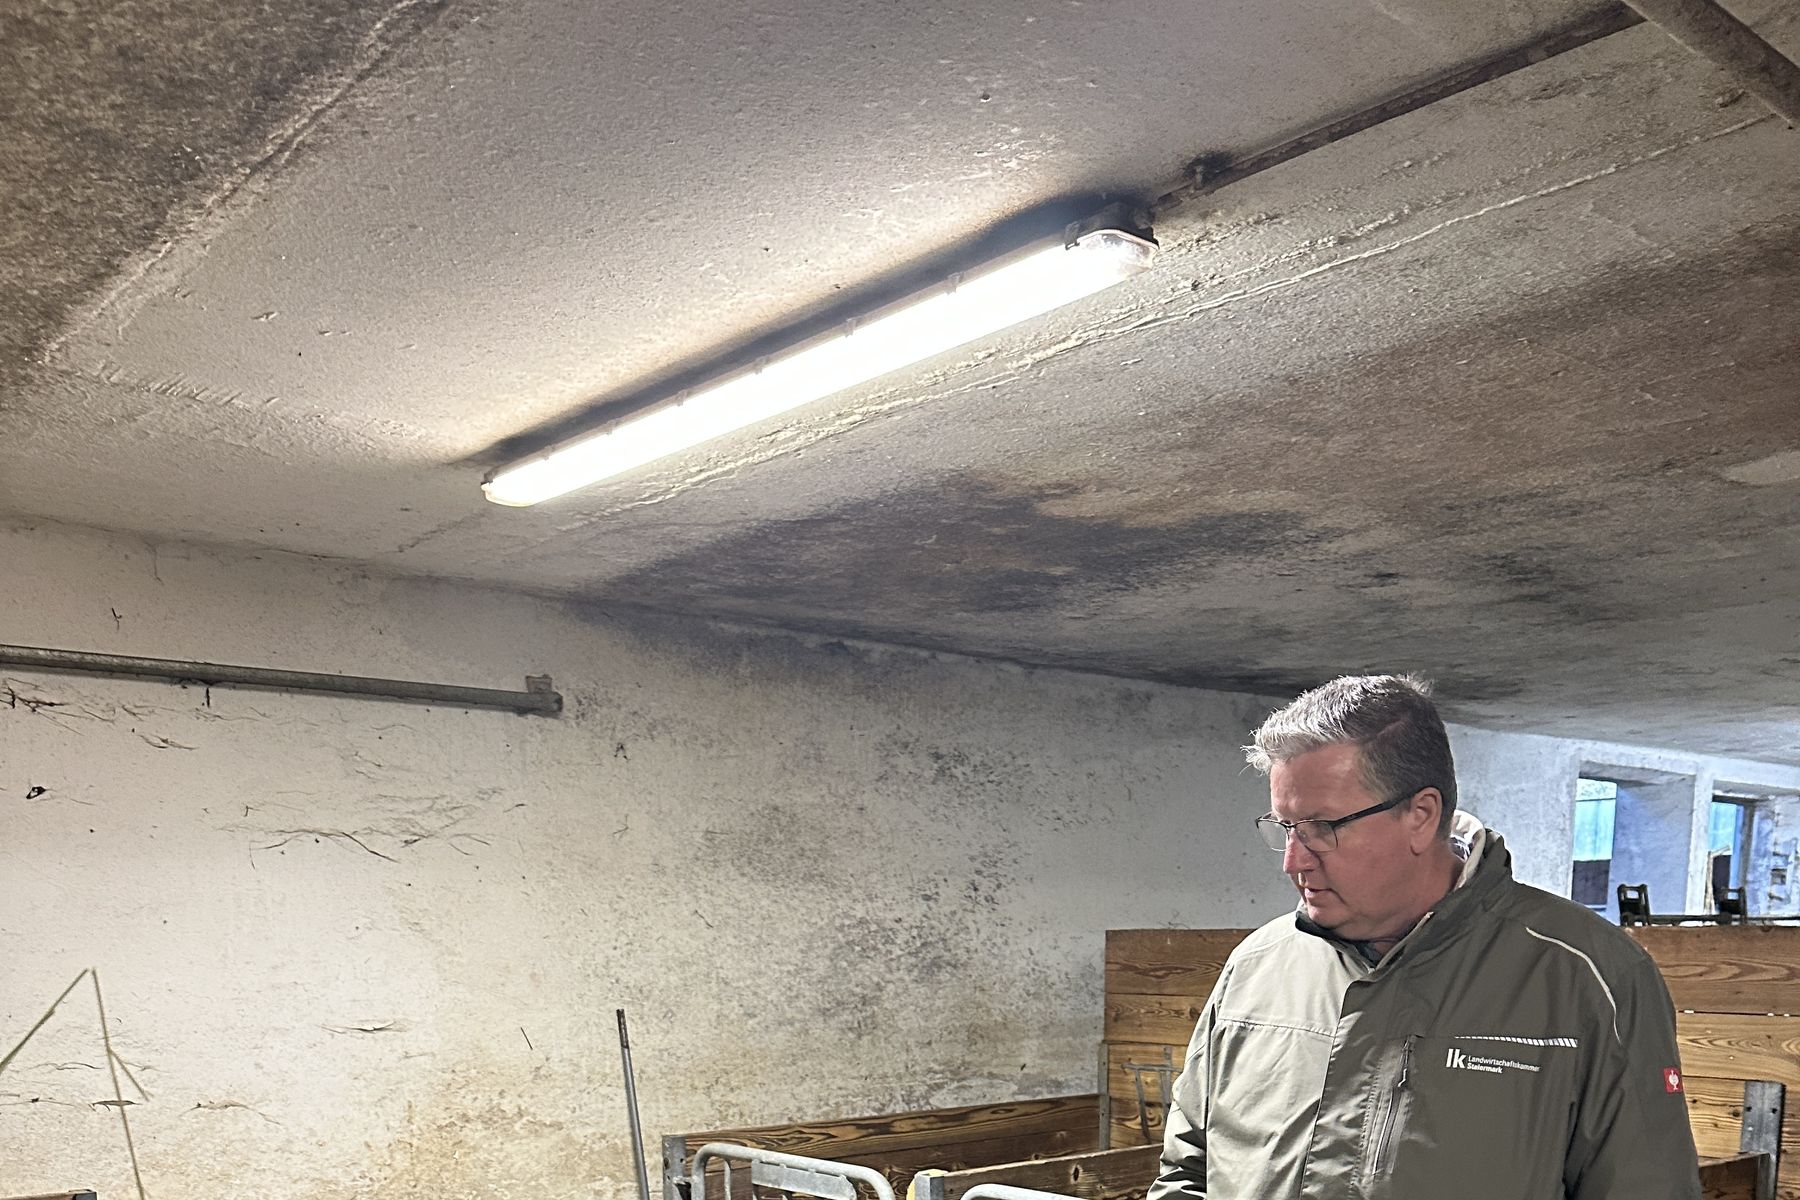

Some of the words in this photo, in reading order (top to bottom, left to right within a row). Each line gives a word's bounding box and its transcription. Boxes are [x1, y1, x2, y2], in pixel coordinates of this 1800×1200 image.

[1445, 1048, 1466, 1069] lk
[1468, 1055, 1540, 1072] Landwirtschaftskammer
[1467, 1062, 1503, 1074] Steiermark
